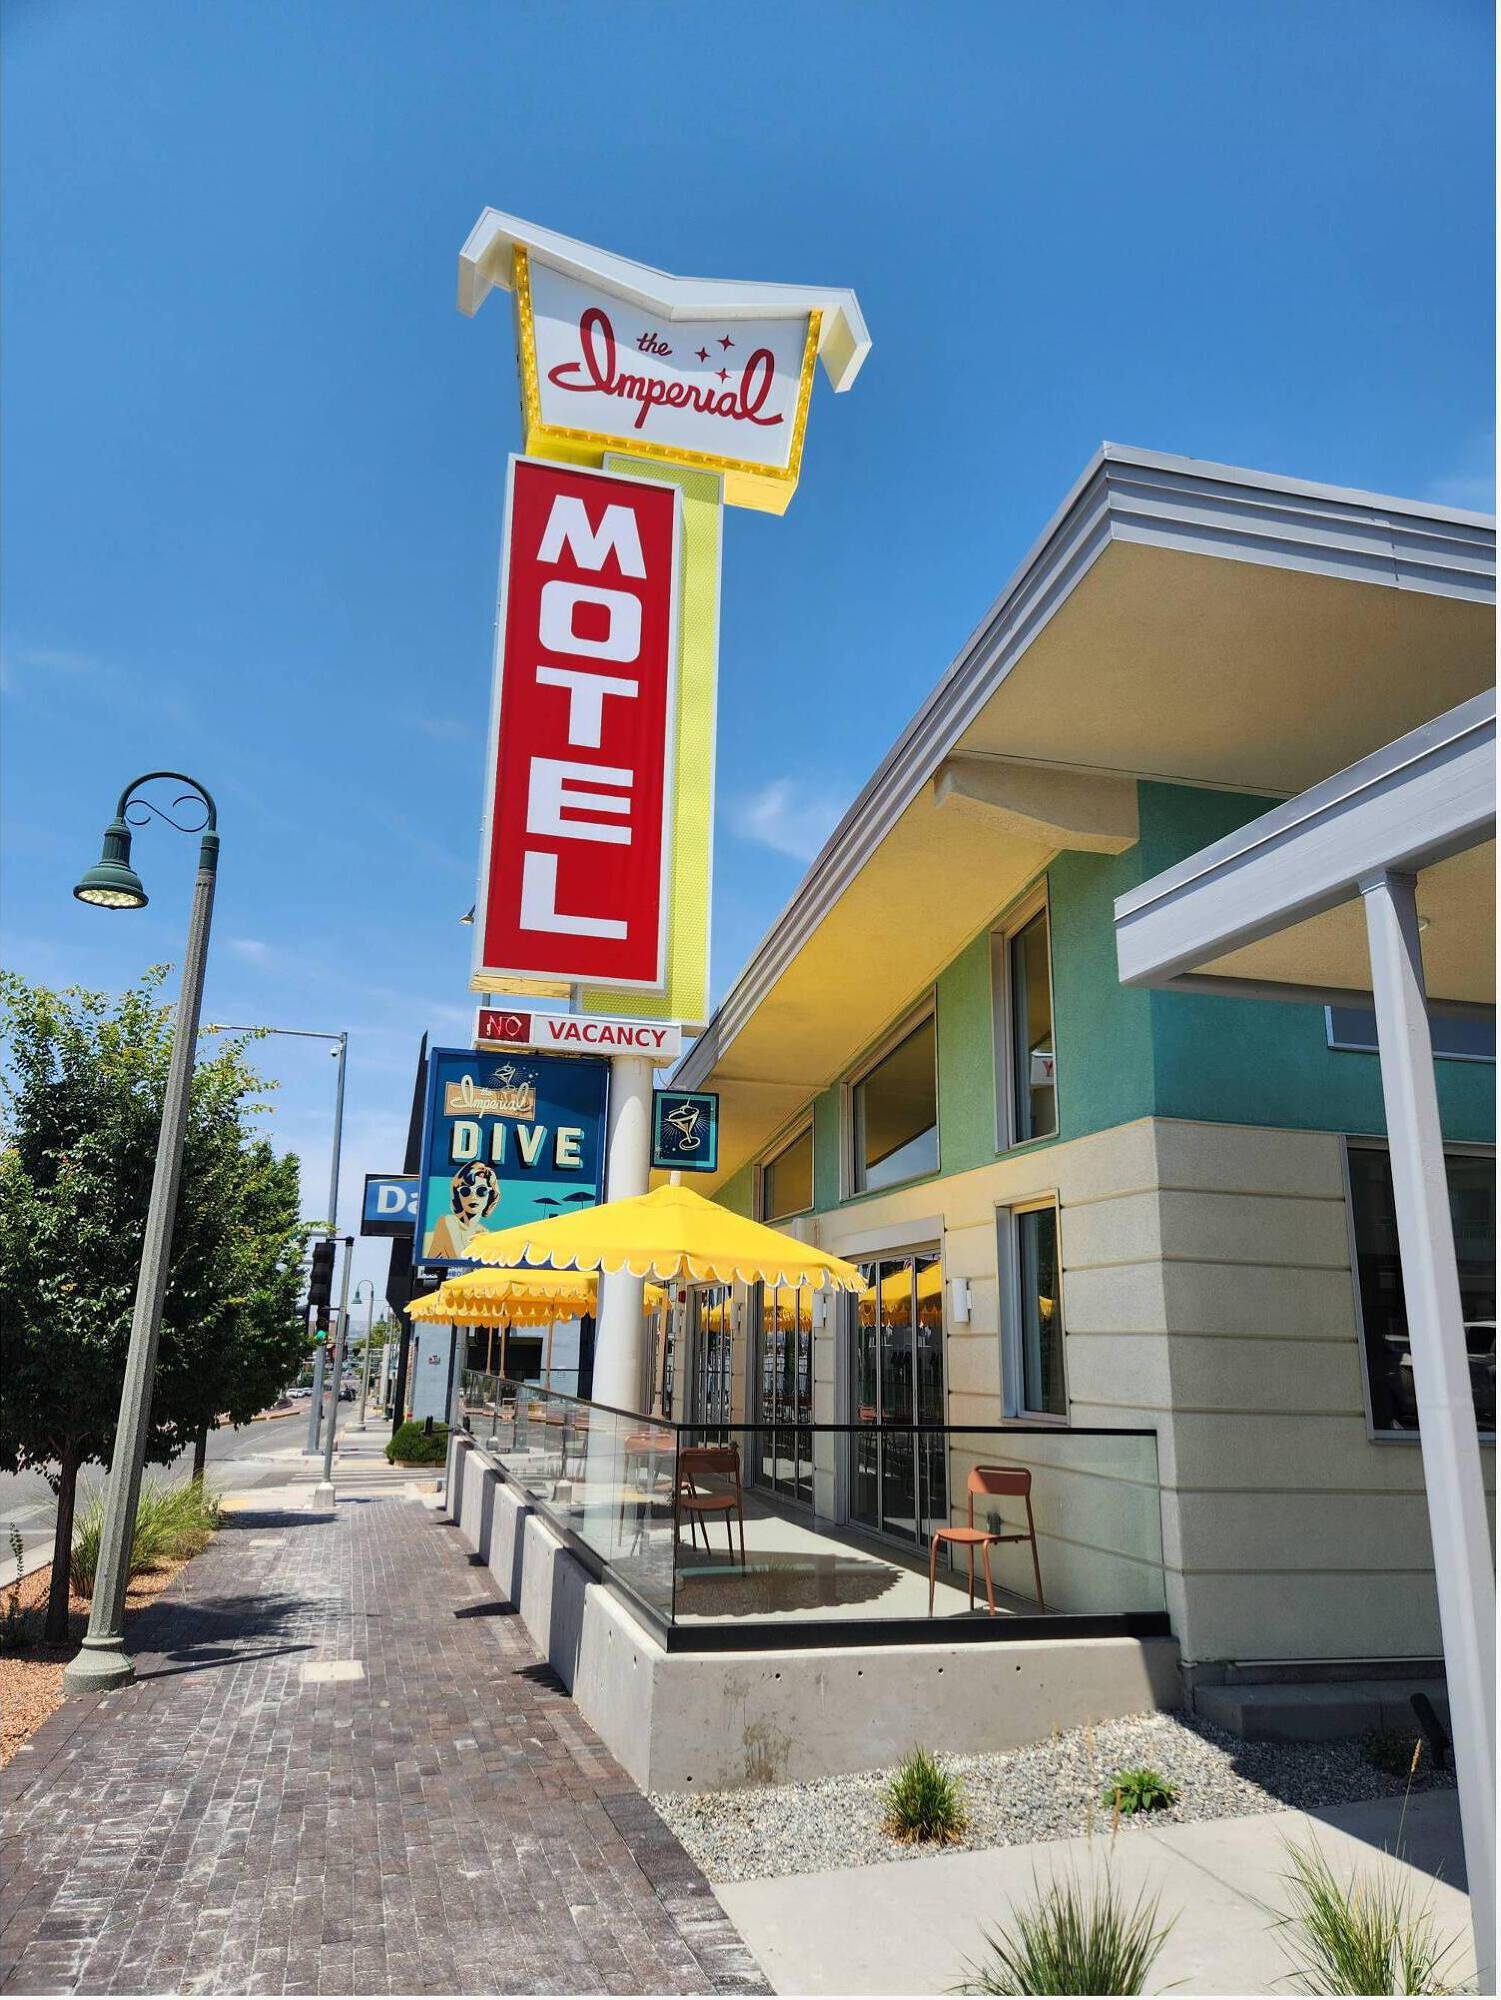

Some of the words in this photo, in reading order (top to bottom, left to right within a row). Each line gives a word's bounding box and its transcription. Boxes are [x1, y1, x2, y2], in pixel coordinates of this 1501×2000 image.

[547, 306, 784, 428] Imperial
[636, 332, 672, 356] the
[519, 493, 647, 940] MOTEL
[486, 1014, 522, 1037] NO
[548, 1020, 668, 1048] VACANCY
[450, 1074, 533, 1119] Imperial
[452, 1120, 584, 1168] DIVE
